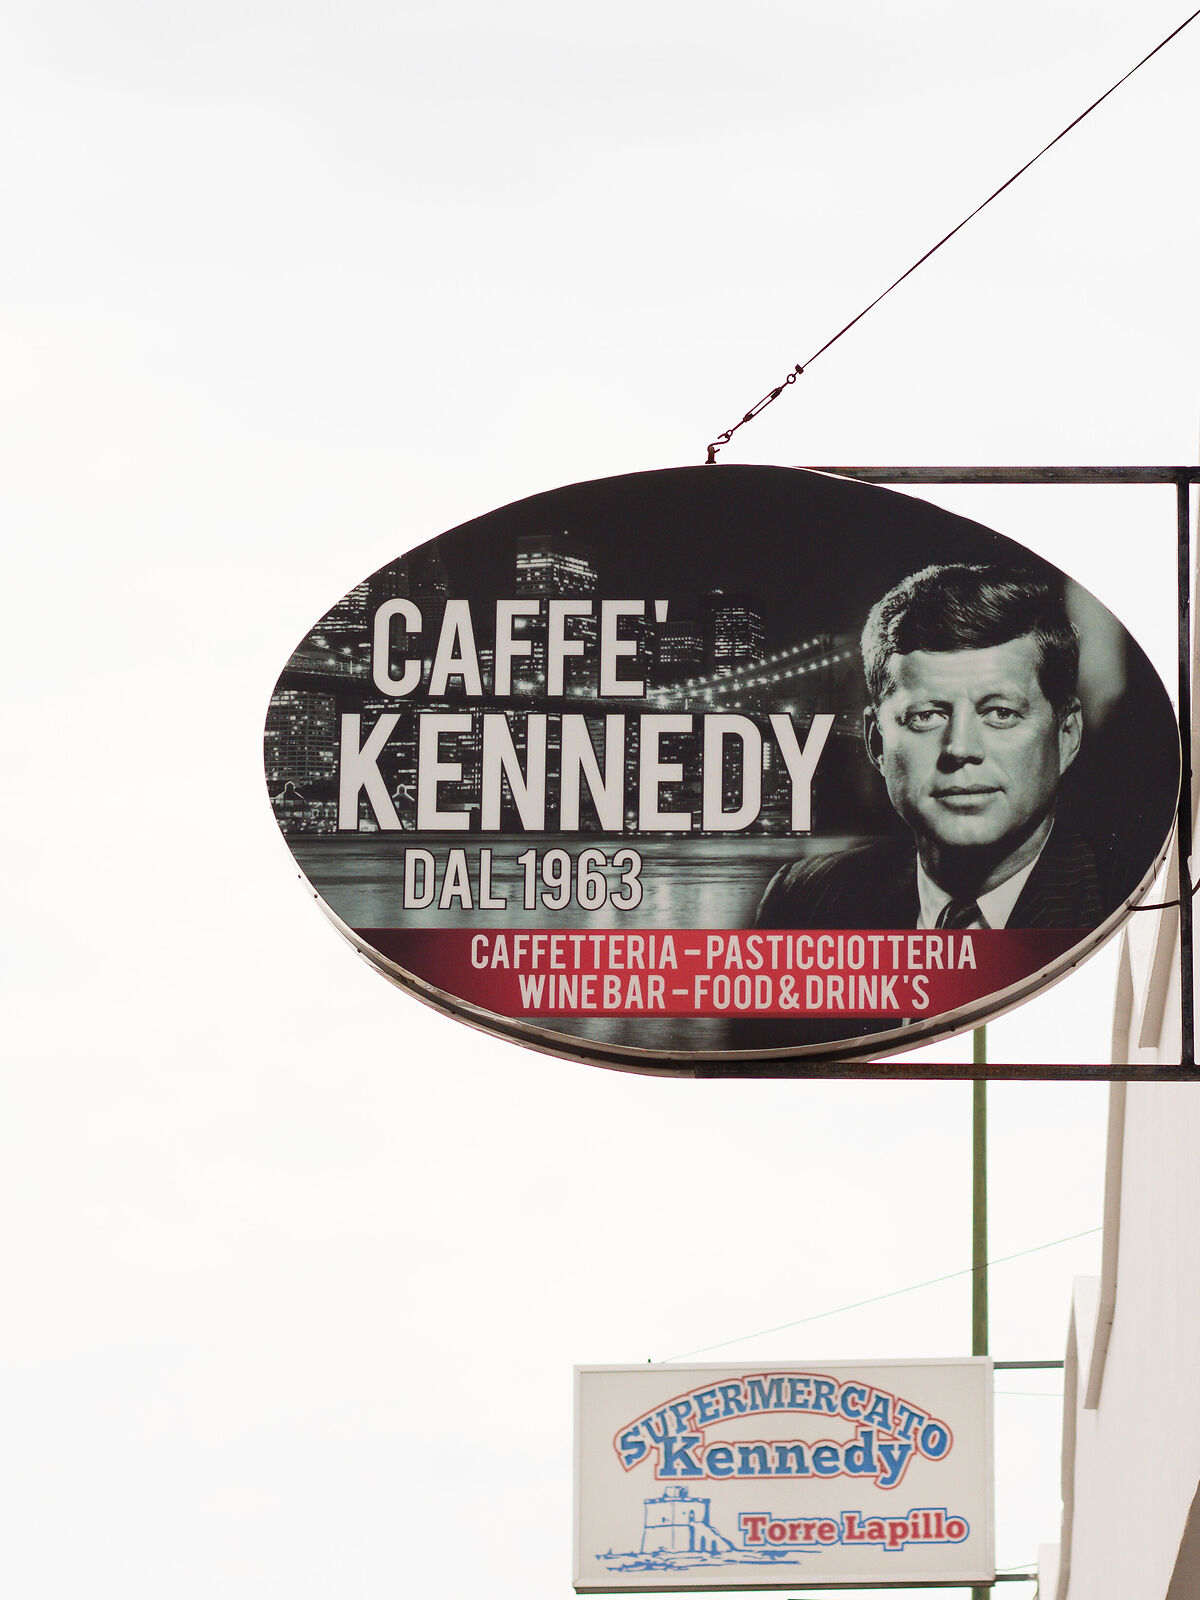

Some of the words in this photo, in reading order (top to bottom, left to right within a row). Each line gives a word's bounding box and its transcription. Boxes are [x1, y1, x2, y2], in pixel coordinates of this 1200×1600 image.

[372, 597, 669, 698] CAFFE'
[337, 712, 837, 832] KENNEDY
[403, 847, 507, 911] DAL
[516, 847, 643, 911] 1963
[470, 934, 678, 970] CAFFETTERIA
[706, 934, 978, 970] PASTICCIOTTERIA
[518, 974, 598, 1009] WINE
[603, 974, 666, 1010] BAR
[694, 974, 773, 1010] FOOD
[806, 974, 930, 1010] DRINK'S
[617, 1375, 951, 1468] SUPERMERCATO
[658, 1430, 913, 1487] Kennedy
[742, 1514, 836, 1544] Torre
[844, 1511, 967, 1548] Lapillo
